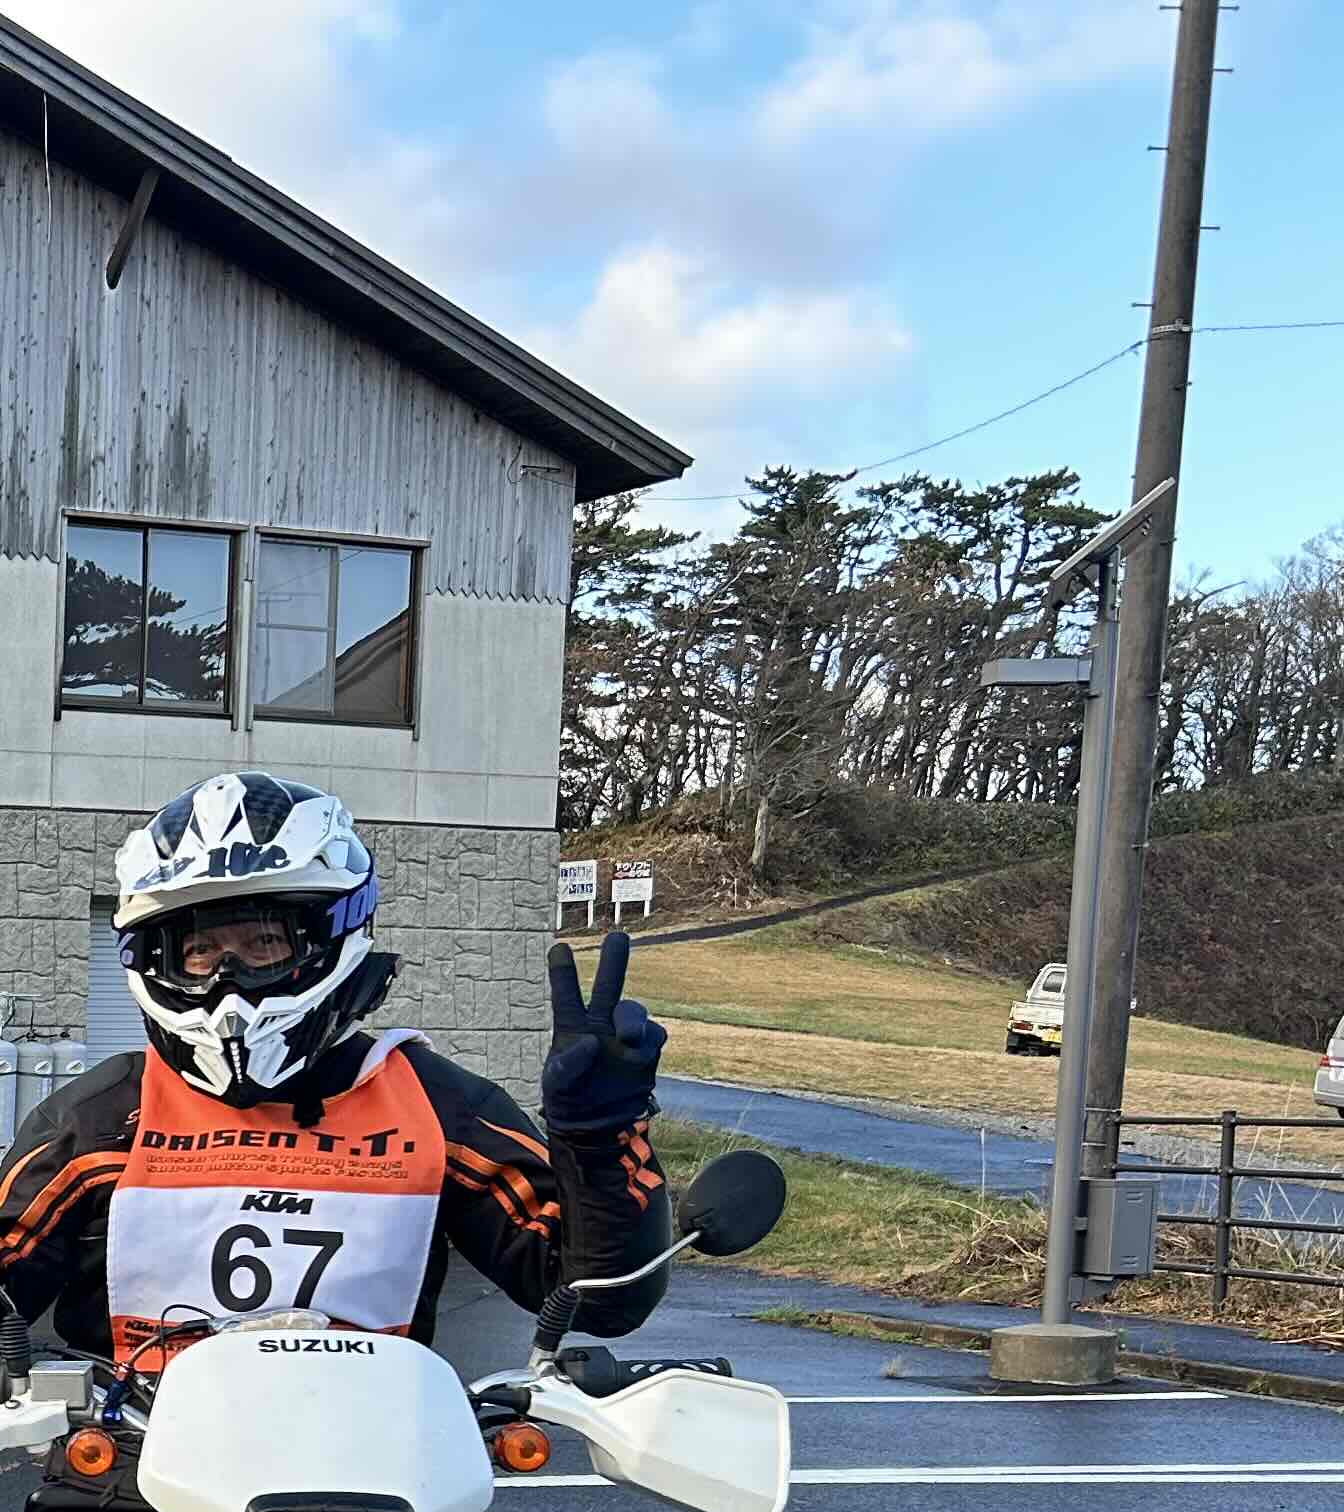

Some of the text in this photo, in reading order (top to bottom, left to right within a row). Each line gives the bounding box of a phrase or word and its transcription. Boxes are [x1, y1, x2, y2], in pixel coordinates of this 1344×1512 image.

[240, 1190, 314, 1215] KTM
[212, 1223, 344, 1312] 67
[258, 1338, 376, 1355] SUZUKI
